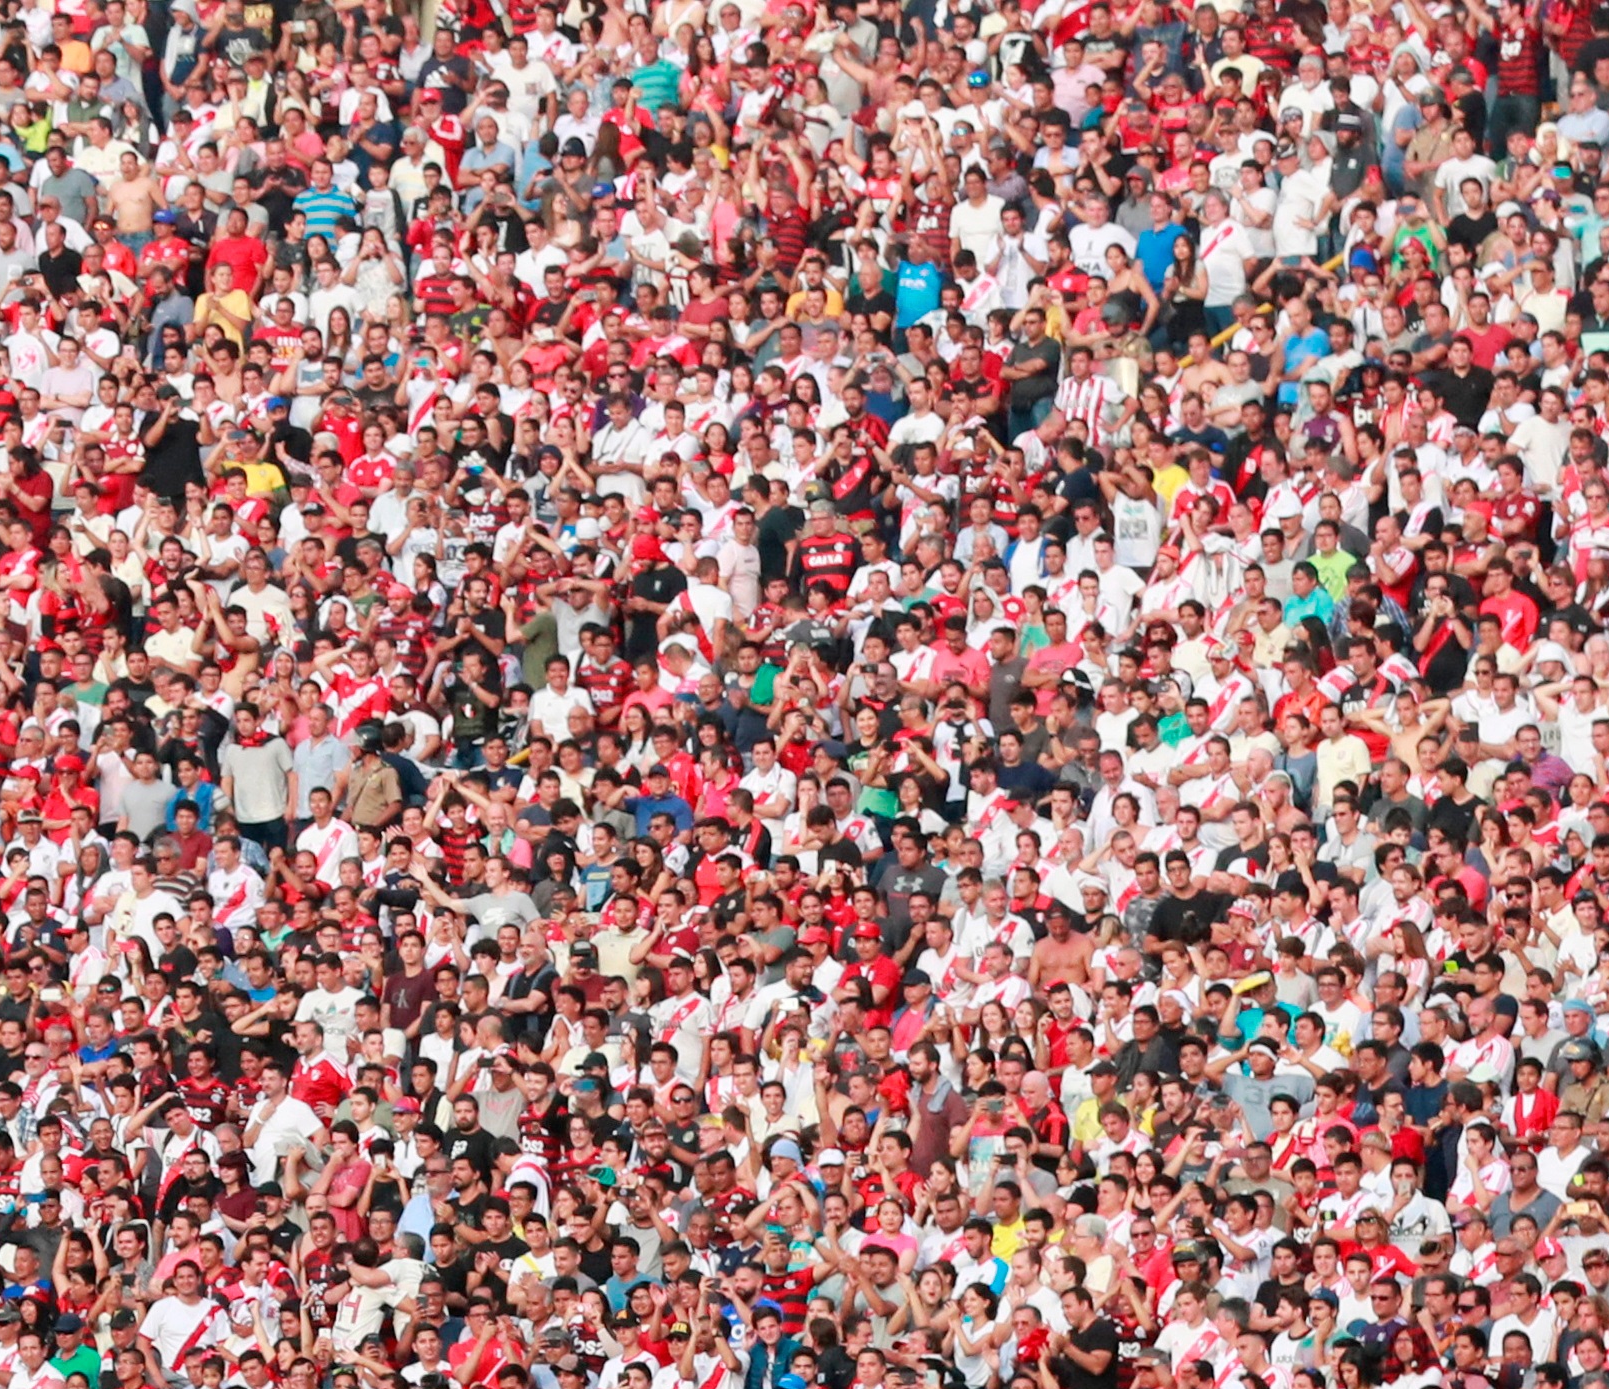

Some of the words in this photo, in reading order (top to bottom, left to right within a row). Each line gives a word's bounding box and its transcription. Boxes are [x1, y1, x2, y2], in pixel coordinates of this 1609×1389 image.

[808, 554, 844, 567] CAIXA
[188, 1107, 212, 1123] s2
[521, 1136, 545, 1153] bs2
